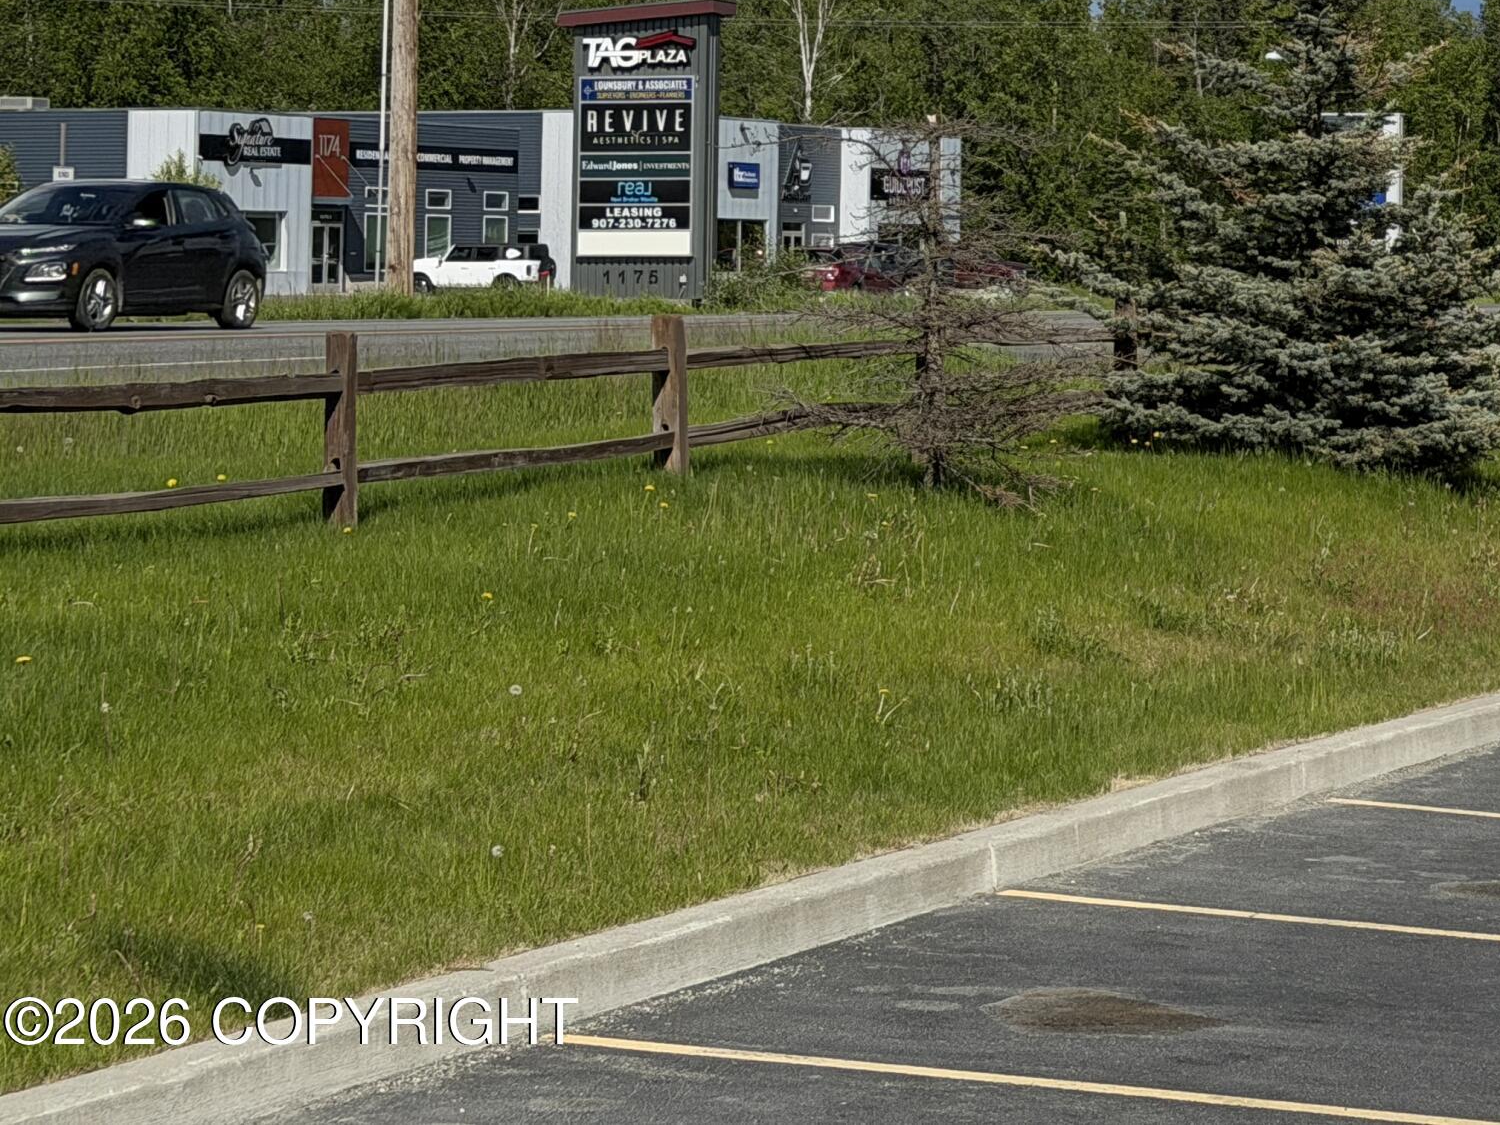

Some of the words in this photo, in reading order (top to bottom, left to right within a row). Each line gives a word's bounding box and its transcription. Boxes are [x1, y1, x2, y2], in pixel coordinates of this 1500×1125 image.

[582, 37, 639, 67] TAG
[640, 49, 687, 64] PLAZA
[645, 79, 688, 90] ASSOCIATES
[587, 109, 685, 132] REVIVE
[319, 134, 341, 156] 1174
[592, 136, 651, 144] AESTHETICS
[662, 136, 679, 144] SPA
[243, 146, 258, 156] REAL
[260, 147, 282, 157] ESTATE
[416, 153, 453, 164] COMMERCIAL
[643, 162, 690, 170] INVESTMENTS
[617, 181, 652, 195] real
[606, 207, 662, 217] LEASING
[592, 218, 677, 228] 907-230-7276
[603, 270, 658, 285] 1175
